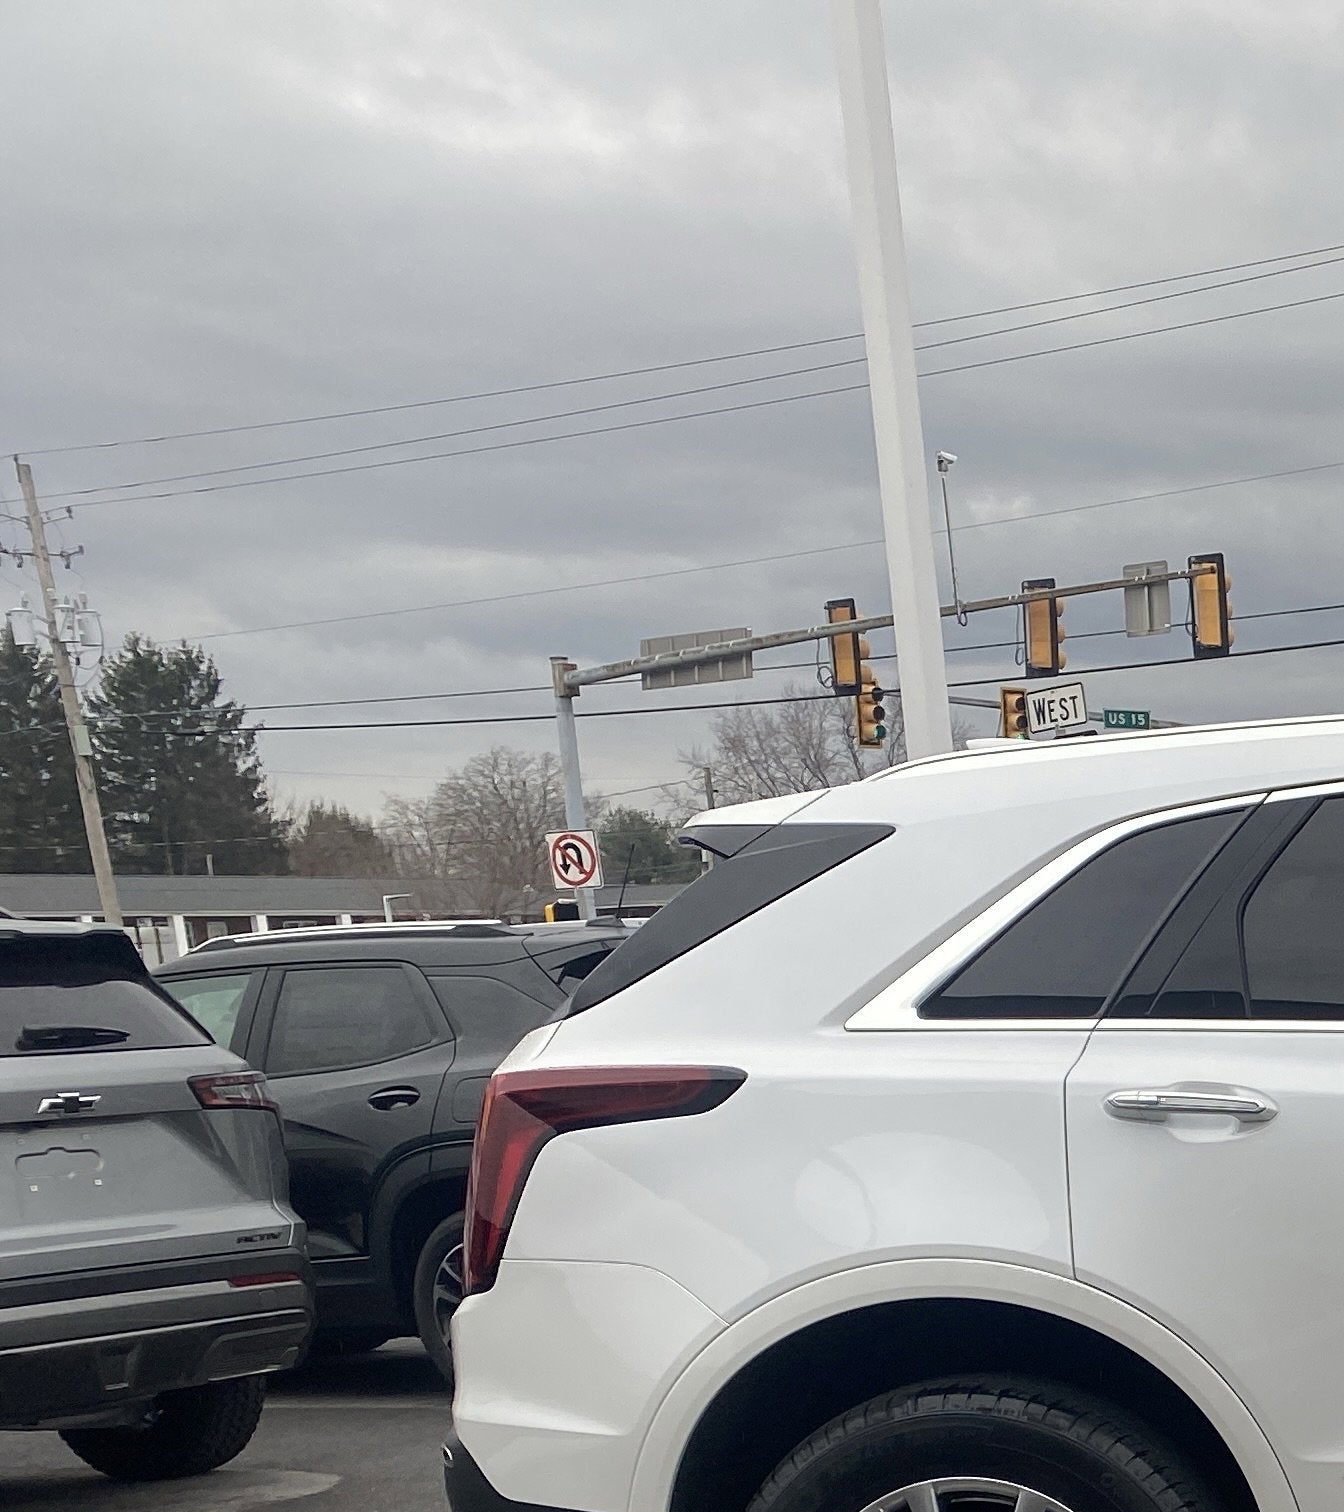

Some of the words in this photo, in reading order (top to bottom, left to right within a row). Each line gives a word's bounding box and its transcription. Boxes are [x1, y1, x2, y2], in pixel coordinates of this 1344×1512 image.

[1032, 694, 1080, 726] WEST
[1108, 712, 1126, 725] US
[1131, 713, 1146, 726] 15
